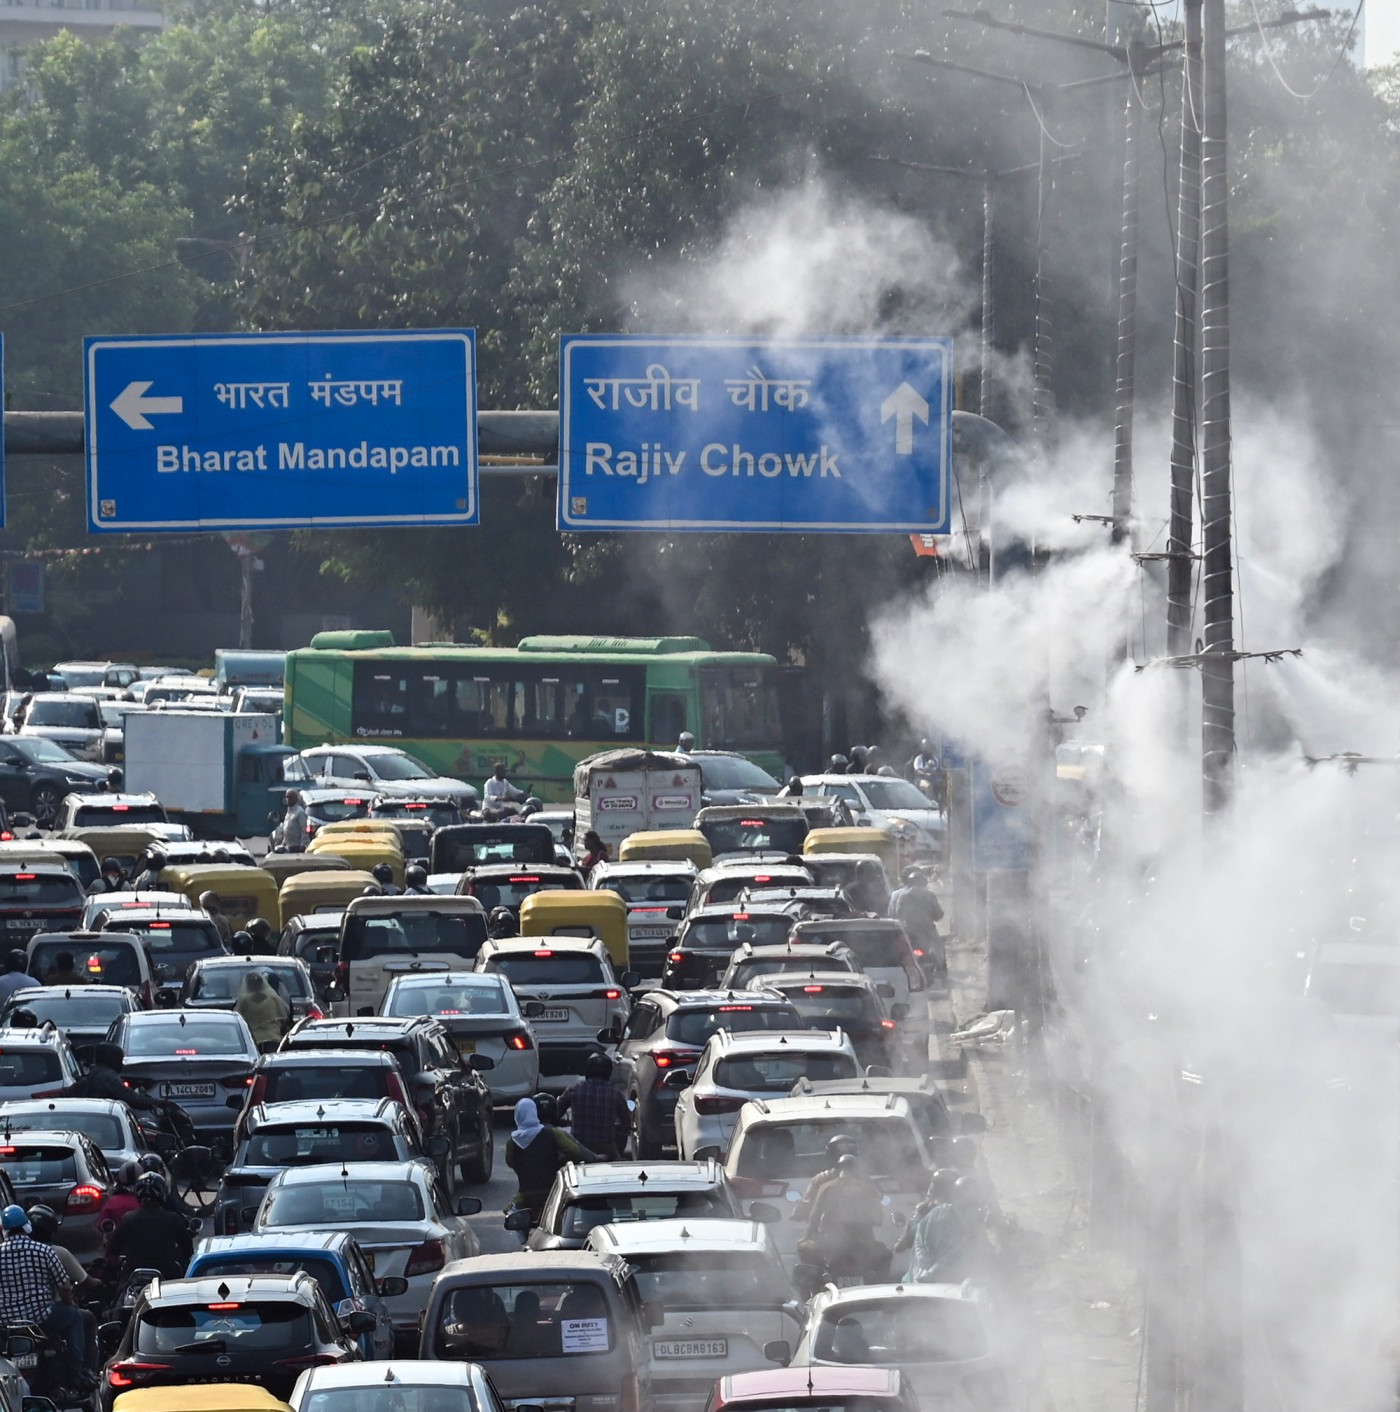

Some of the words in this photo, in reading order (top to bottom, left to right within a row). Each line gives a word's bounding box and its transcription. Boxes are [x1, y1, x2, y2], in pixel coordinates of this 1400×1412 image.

[214, 382, 290, 408] भारत
[308, 373, 402, 407] मंडपम
[584, 363, 700, 411] राजीव
[724, 366, 811, 411] चौक
[157, 445, 267, 472] Bharat
[279, 441, 459, 474] Mandapam
[585, 443, 686, 484] Rajiv
[700, 443, 841, 477] Chowk
[187, 1375, 262, 1383] MAGNITE
